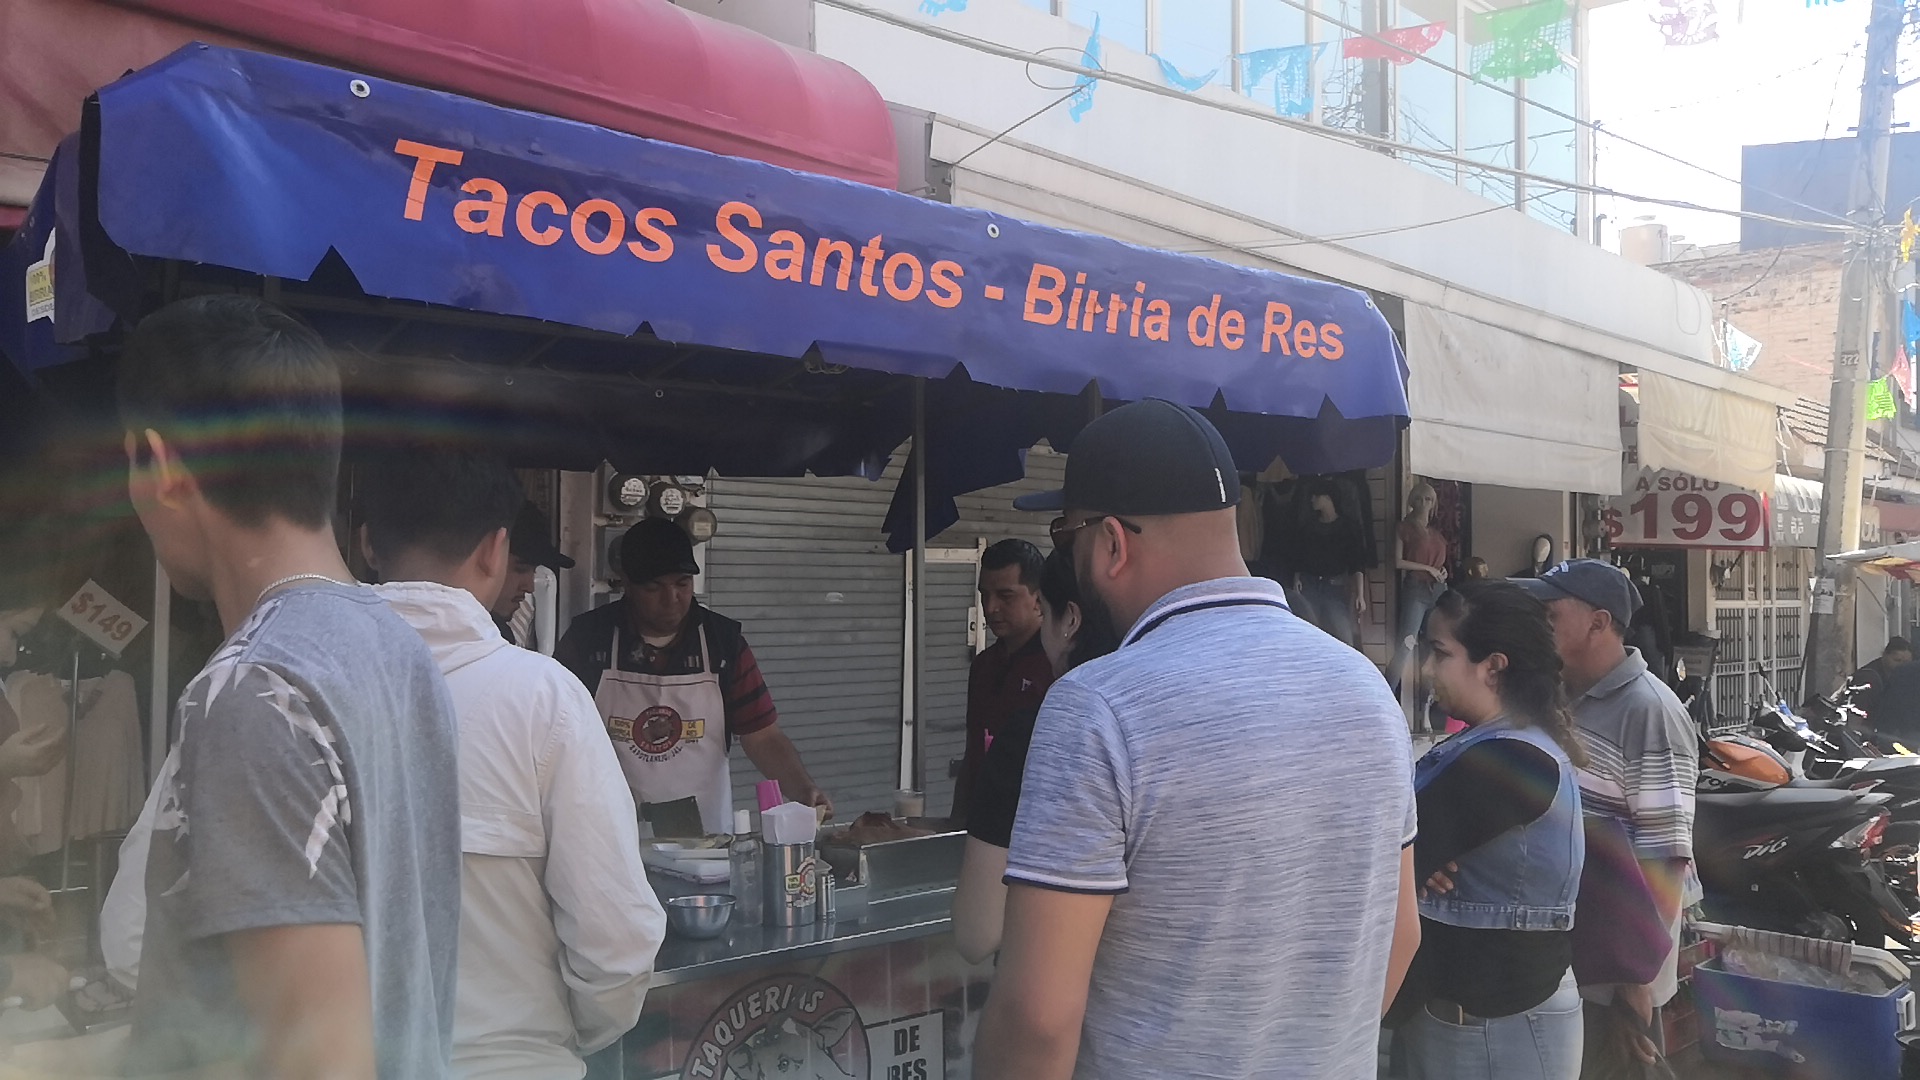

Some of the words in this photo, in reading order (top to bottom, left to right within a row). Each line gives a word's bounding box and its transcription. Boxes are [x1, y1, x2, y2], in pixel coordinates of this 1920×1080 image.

[397, 140, 677, 262] Tacos
[707, 202, 964, 308] Santos
[986, 286, 1004, 300] -
[1024, 265, 1171, 341] Birria
[1188, 295, 1245, 350] de
[1263, 302, 1343, 359] Res
[1636, 476, 1651, 491] A
[1603, 492, 1761, 541] $199
[71, 592, 133, 641] $149
[894, 1025, 920, 1056] DE
[887, 1058, 927, 1080] RES
